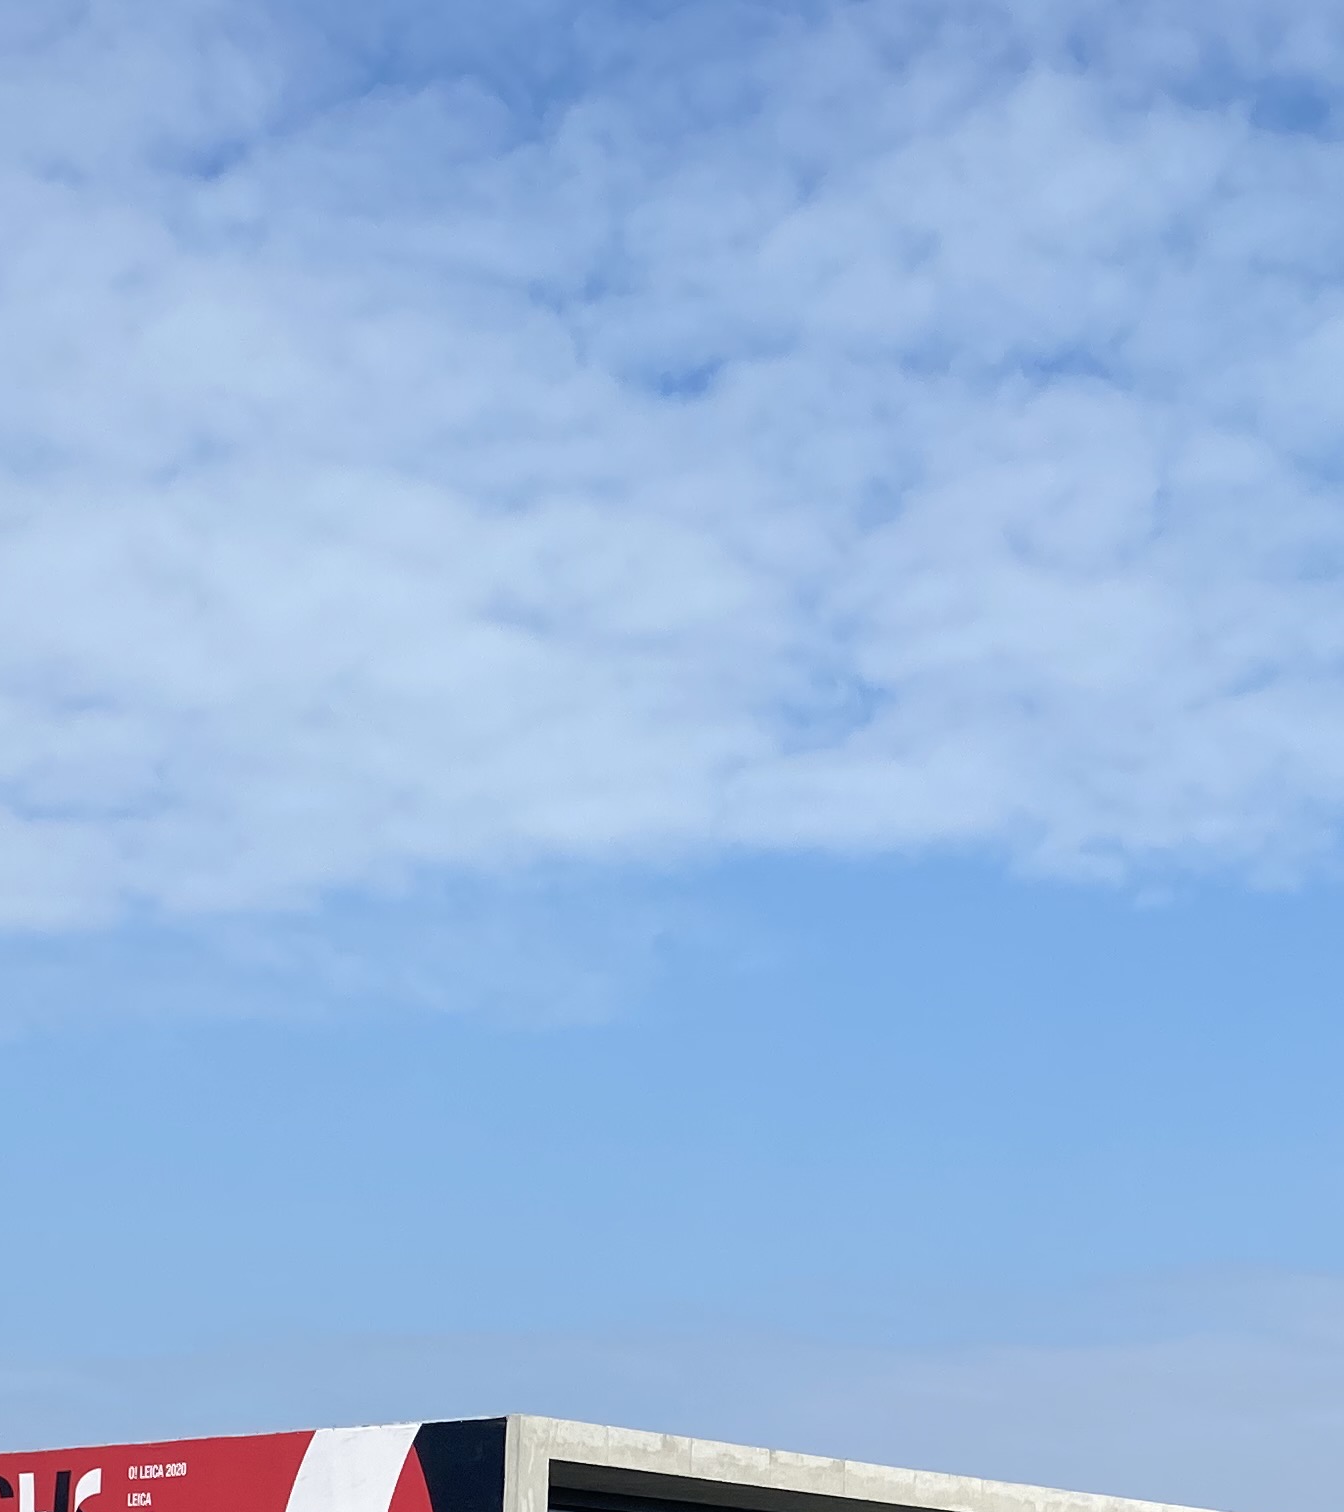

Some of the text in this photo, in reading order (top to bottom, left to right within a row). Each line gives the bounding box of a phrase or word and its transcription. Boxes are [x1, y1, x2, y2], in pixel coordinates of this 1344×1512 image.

[139, 1464, 164, 1479] LEICA
[165, 1462, 187, 1478] 2020
[127, 1492, 152, 1507] LEICA
